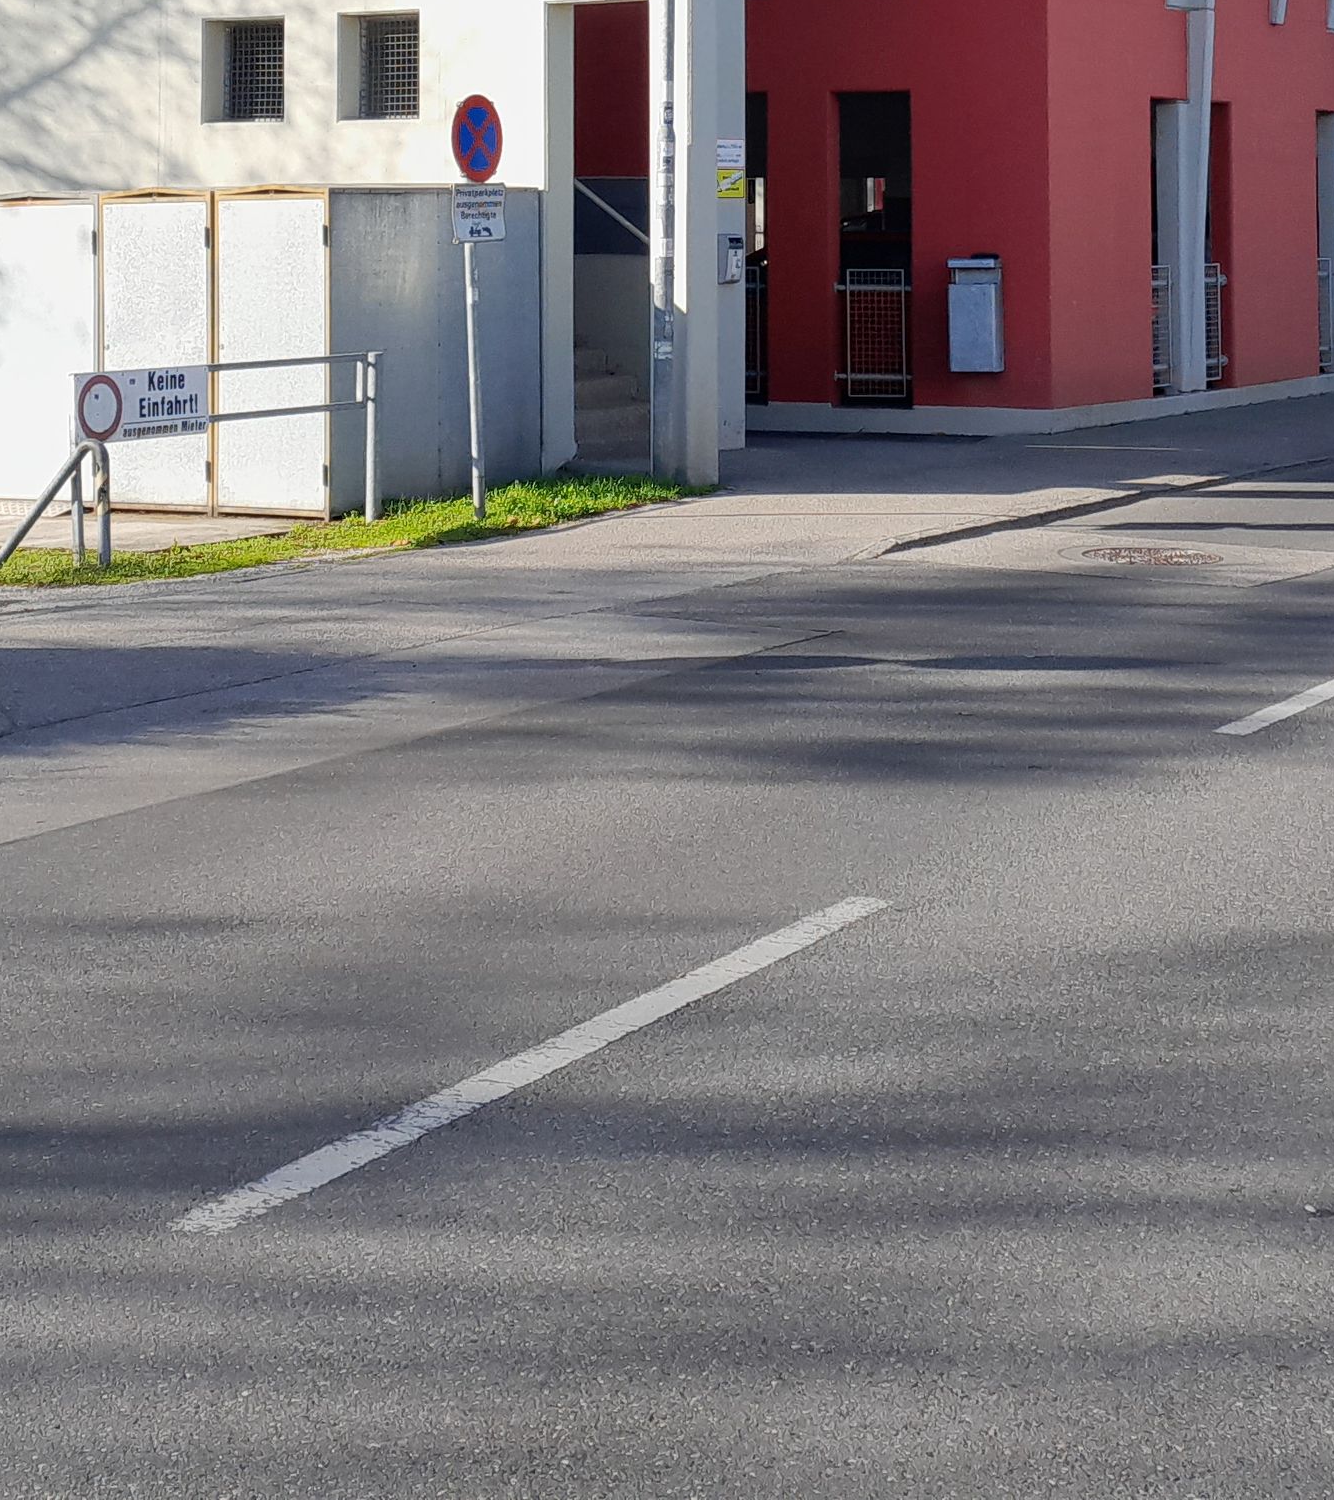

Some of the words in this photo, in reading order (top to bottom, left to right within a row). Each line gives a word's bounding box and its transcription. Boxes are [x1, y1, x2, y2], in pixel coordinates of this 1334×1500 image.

[147, 370, 185, 391] Keine
[138, 393, 198, 418] Einfahrt!
[122, 423, 178, 438] ausgenommen
[180, 420, 206, 432] Mieter
